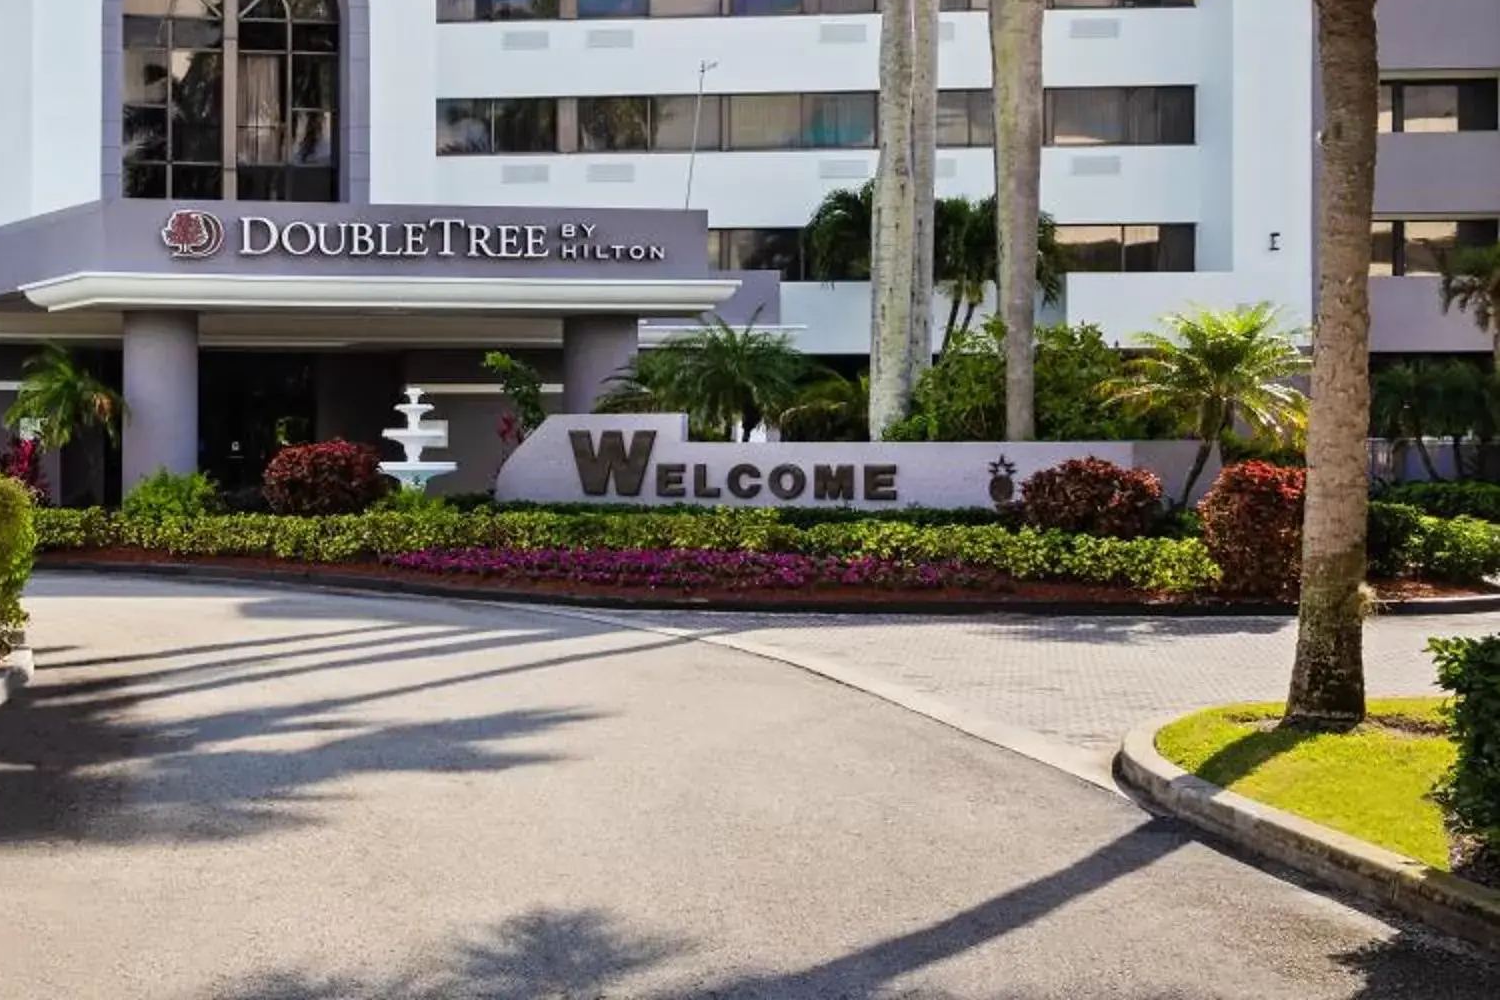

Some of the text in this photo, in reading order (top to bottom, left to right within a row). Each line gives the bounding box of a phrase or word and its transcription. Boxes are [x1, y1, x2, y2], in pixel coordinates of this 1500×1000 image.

[239, 216, 596, 258] DOUBLETREE BY
[561, 244, 665, 260] HILTON
[568, 429, 897, 501] WELCOME
